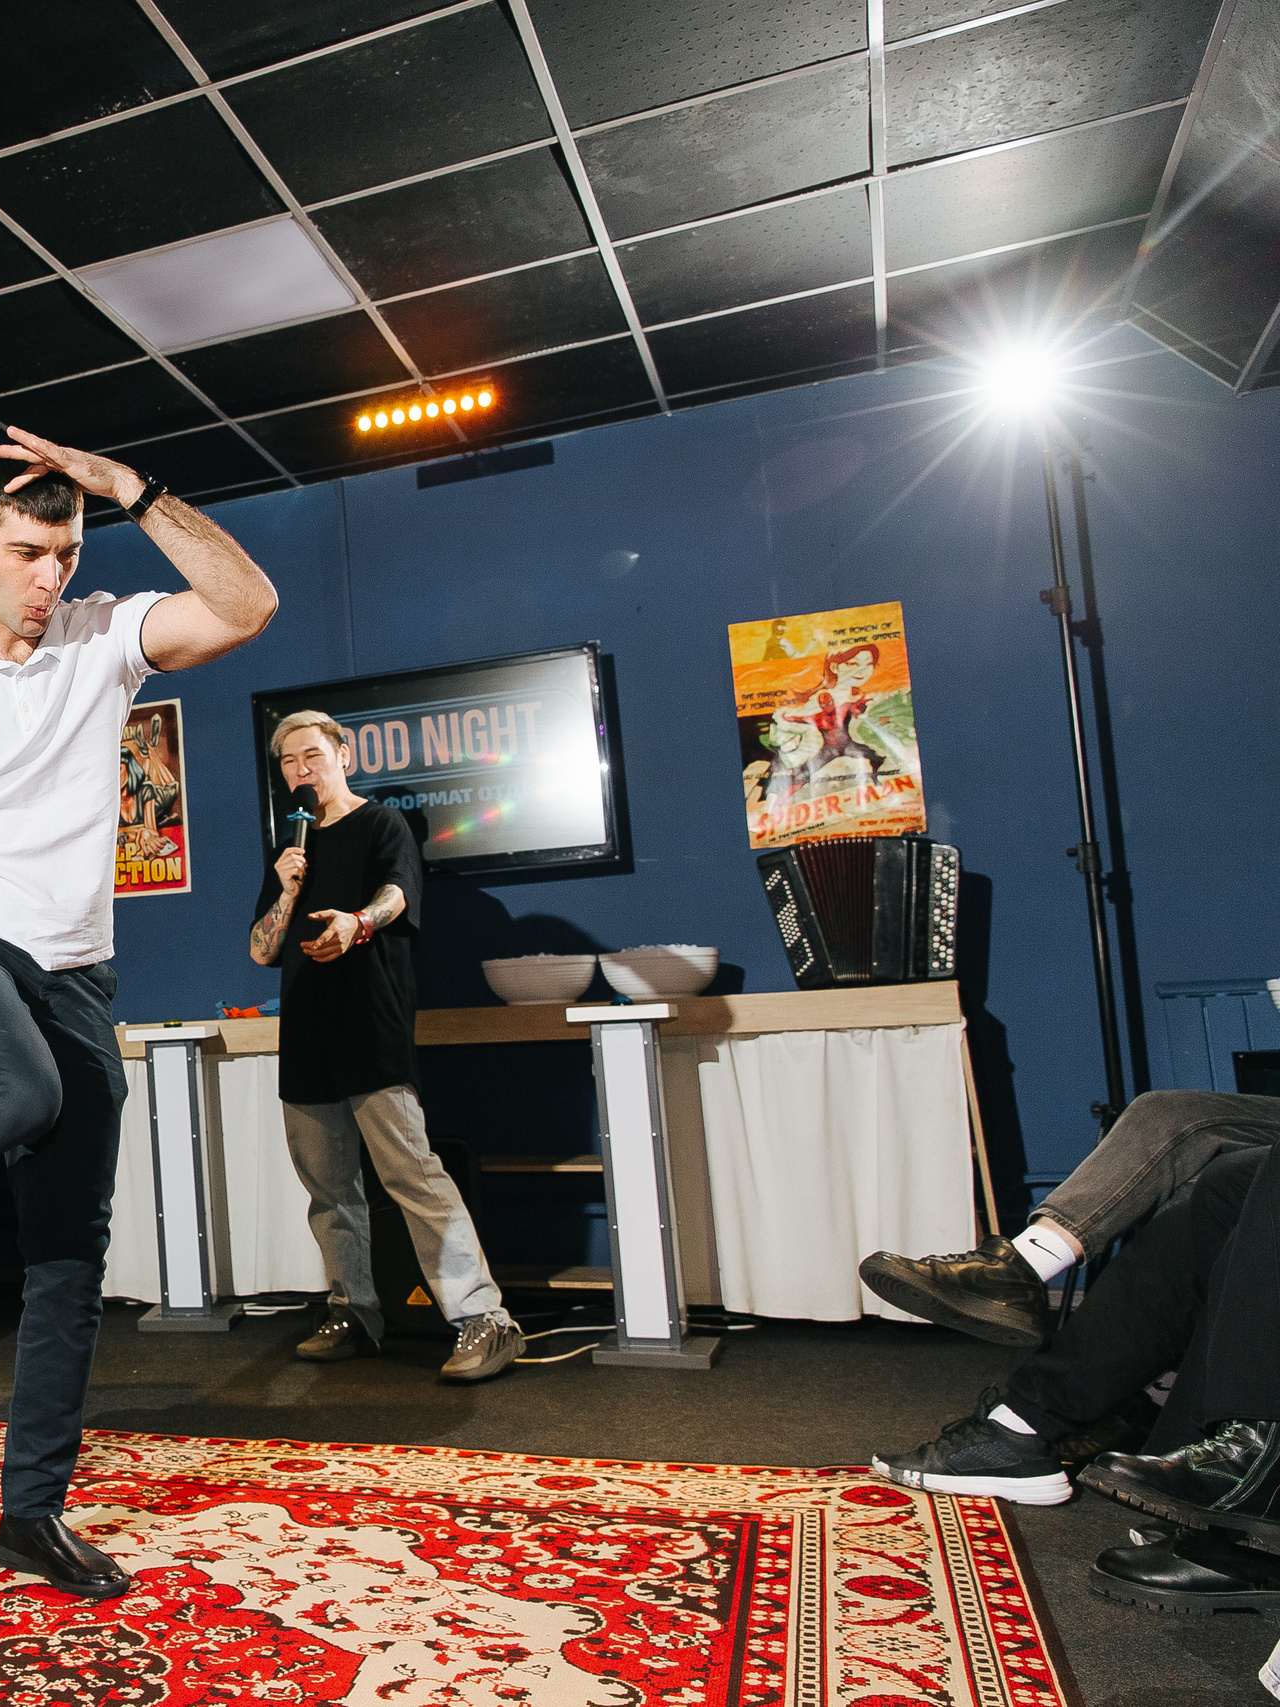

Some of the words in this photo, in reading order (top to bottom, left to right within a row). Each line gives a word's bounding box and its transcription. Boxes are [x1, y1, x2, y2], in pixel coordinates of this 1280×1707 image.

[341, 720, 411, 777] OOD
[420, 701, 542, 767] NIGHT
[382, 787, 474, 810] ФОРМАТ
[756, 775, 915, 840] SPIDER-MAN
[116, 842, 137, 862] LP
[115, 856, 182, 886] CTION
